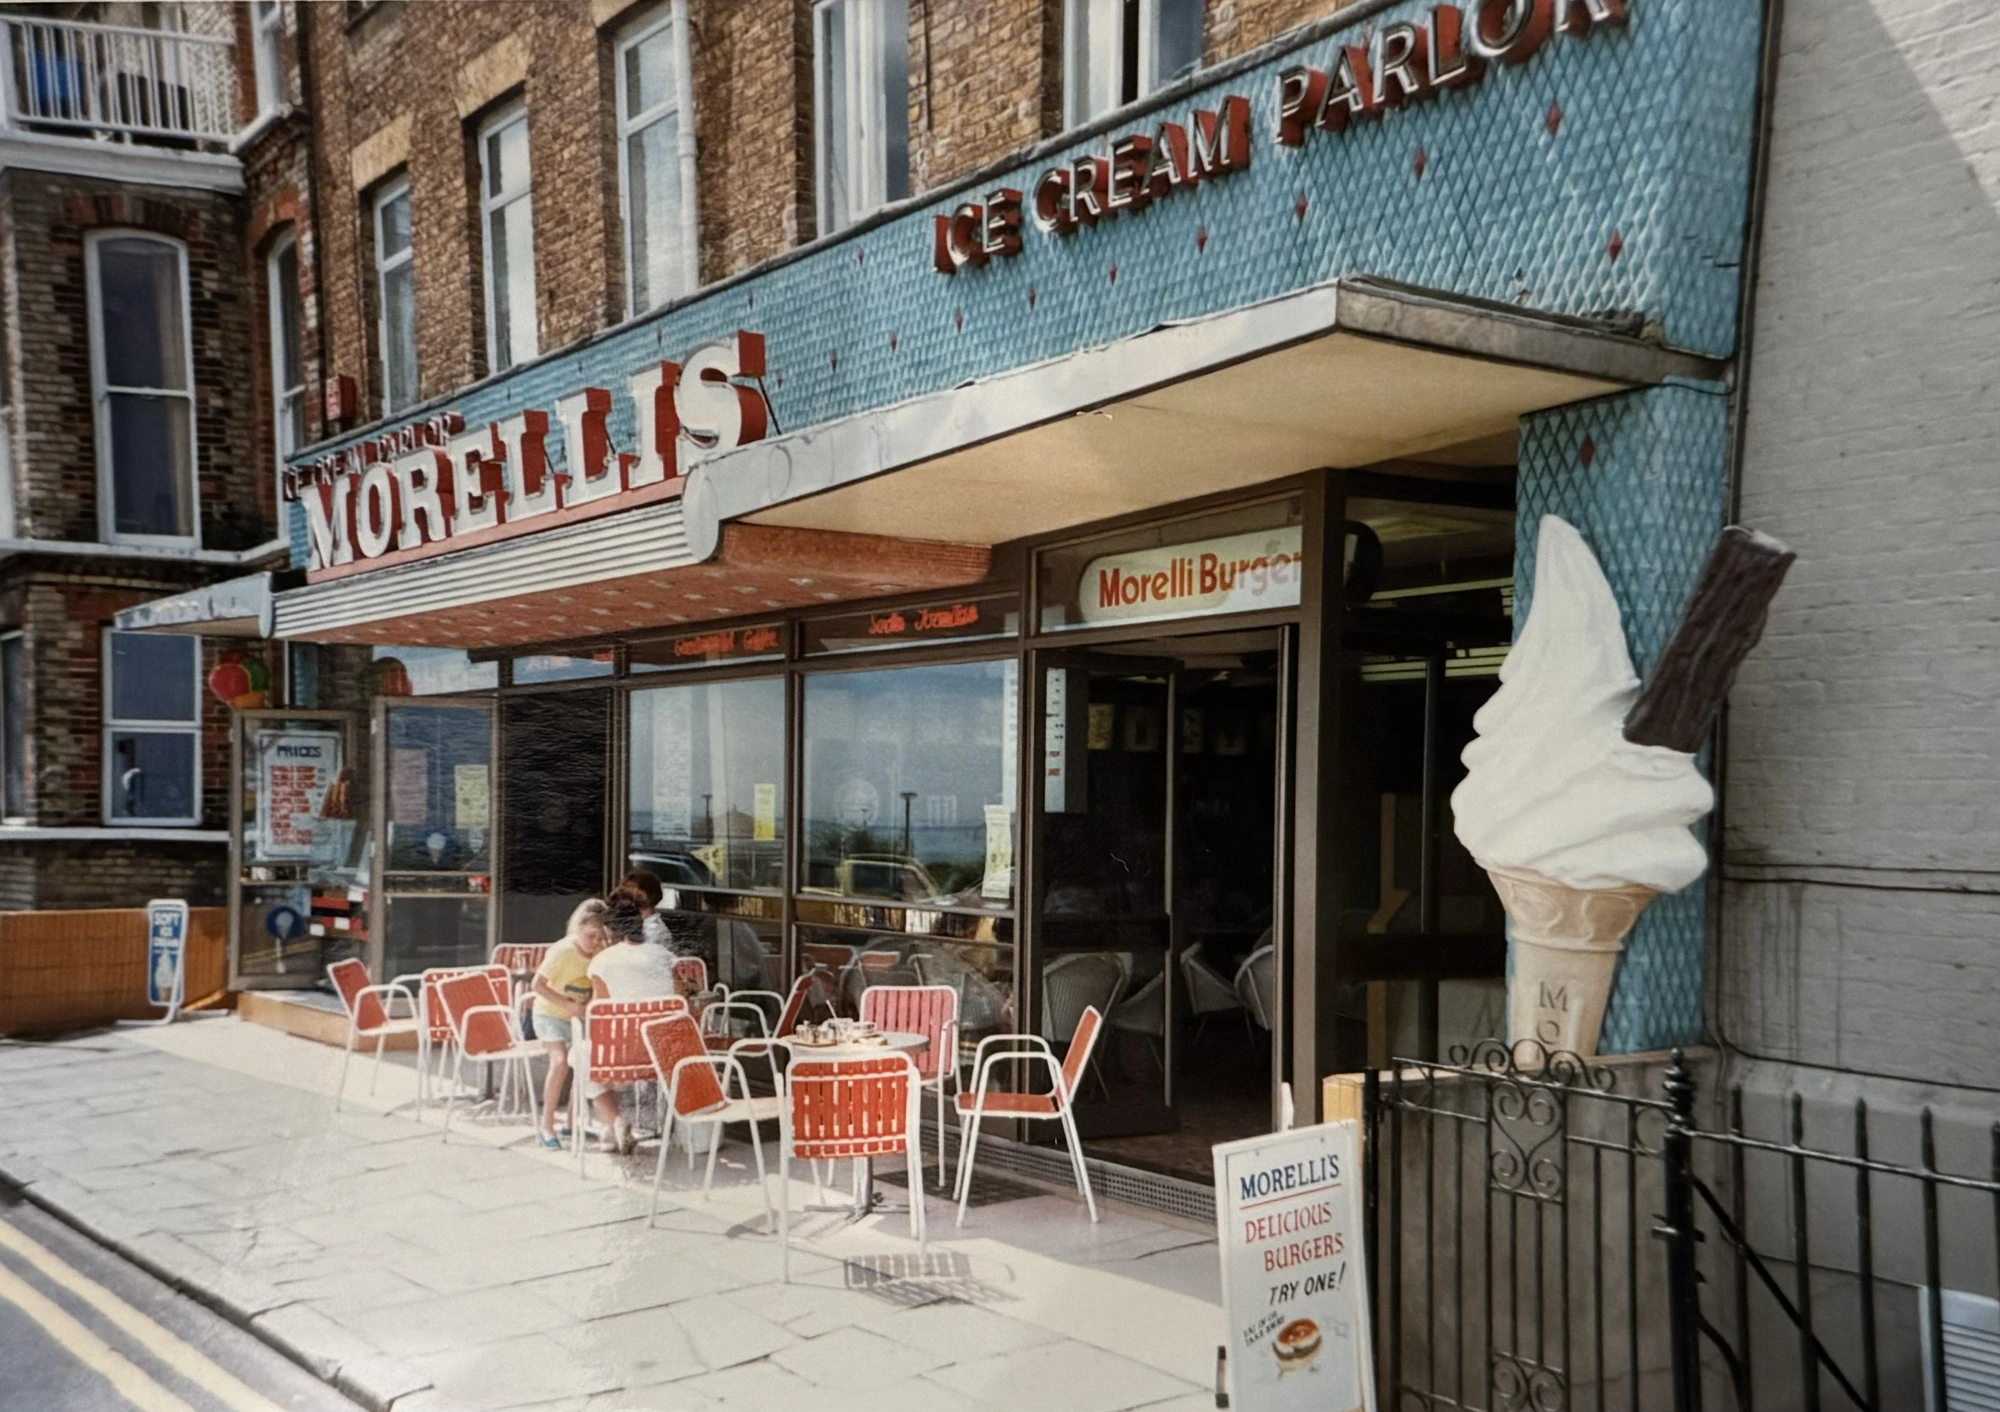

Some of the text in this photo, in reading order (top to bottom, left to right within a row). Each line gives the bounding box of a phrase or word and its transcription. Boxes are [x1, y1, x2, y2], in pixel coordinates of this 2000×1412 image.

[933, 187, 1023, 275] ICE
[1032, 94, 1251, 237] CREAM
[1099, 552, 1301, 608] Morelli Burger
[276, 744, 322, 758] PRICES
[1239, 1154, 1340, 1200] MORELLI'S
[1245, 1202, 1332, 1244] DELICIOUS
[1263, 1232, 1344, 1272] BURGERS
[1270, 1261, 1346, 1306] TRY ONE!
